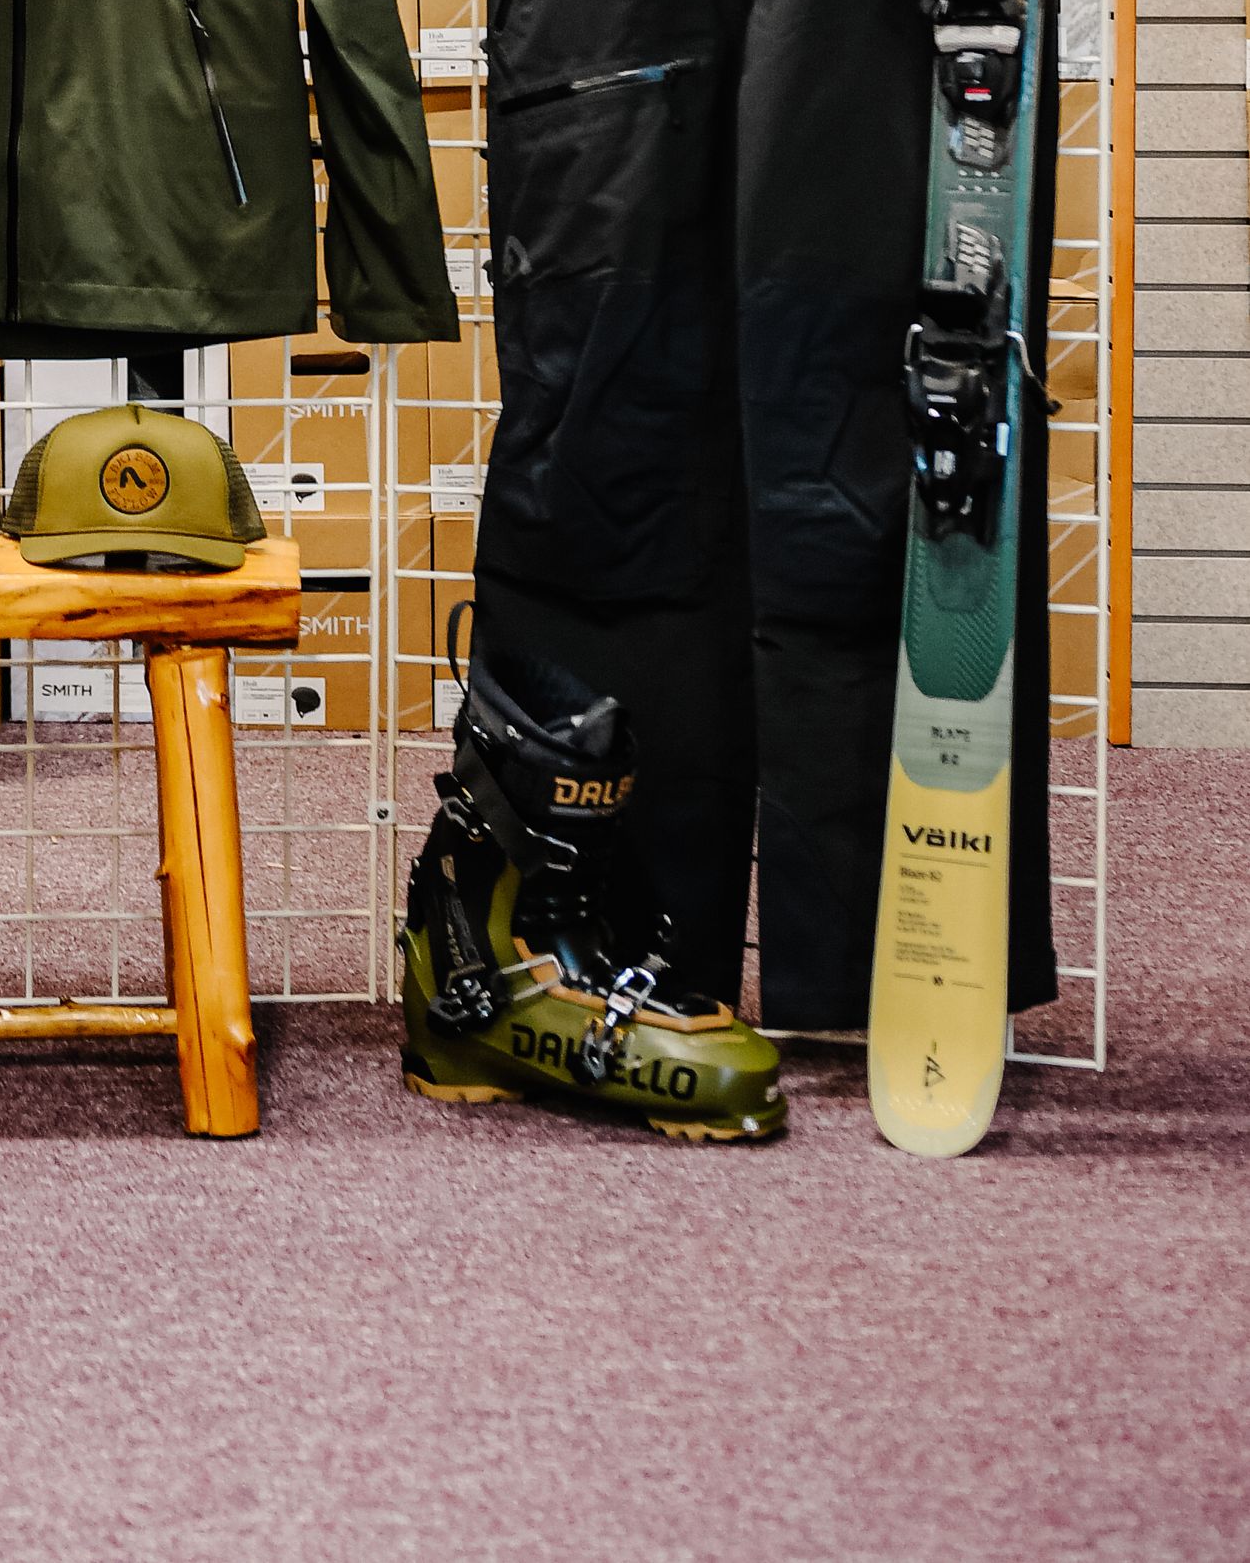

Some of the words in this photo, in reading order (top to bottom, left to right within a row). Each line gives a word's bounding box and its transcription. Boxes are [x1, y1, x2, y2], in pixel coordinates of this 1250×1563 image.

[299, 615, 371, 636] SMITH
[41, 684, 92, 697] SMITH
[902, 824, 992, 853] Völkl
